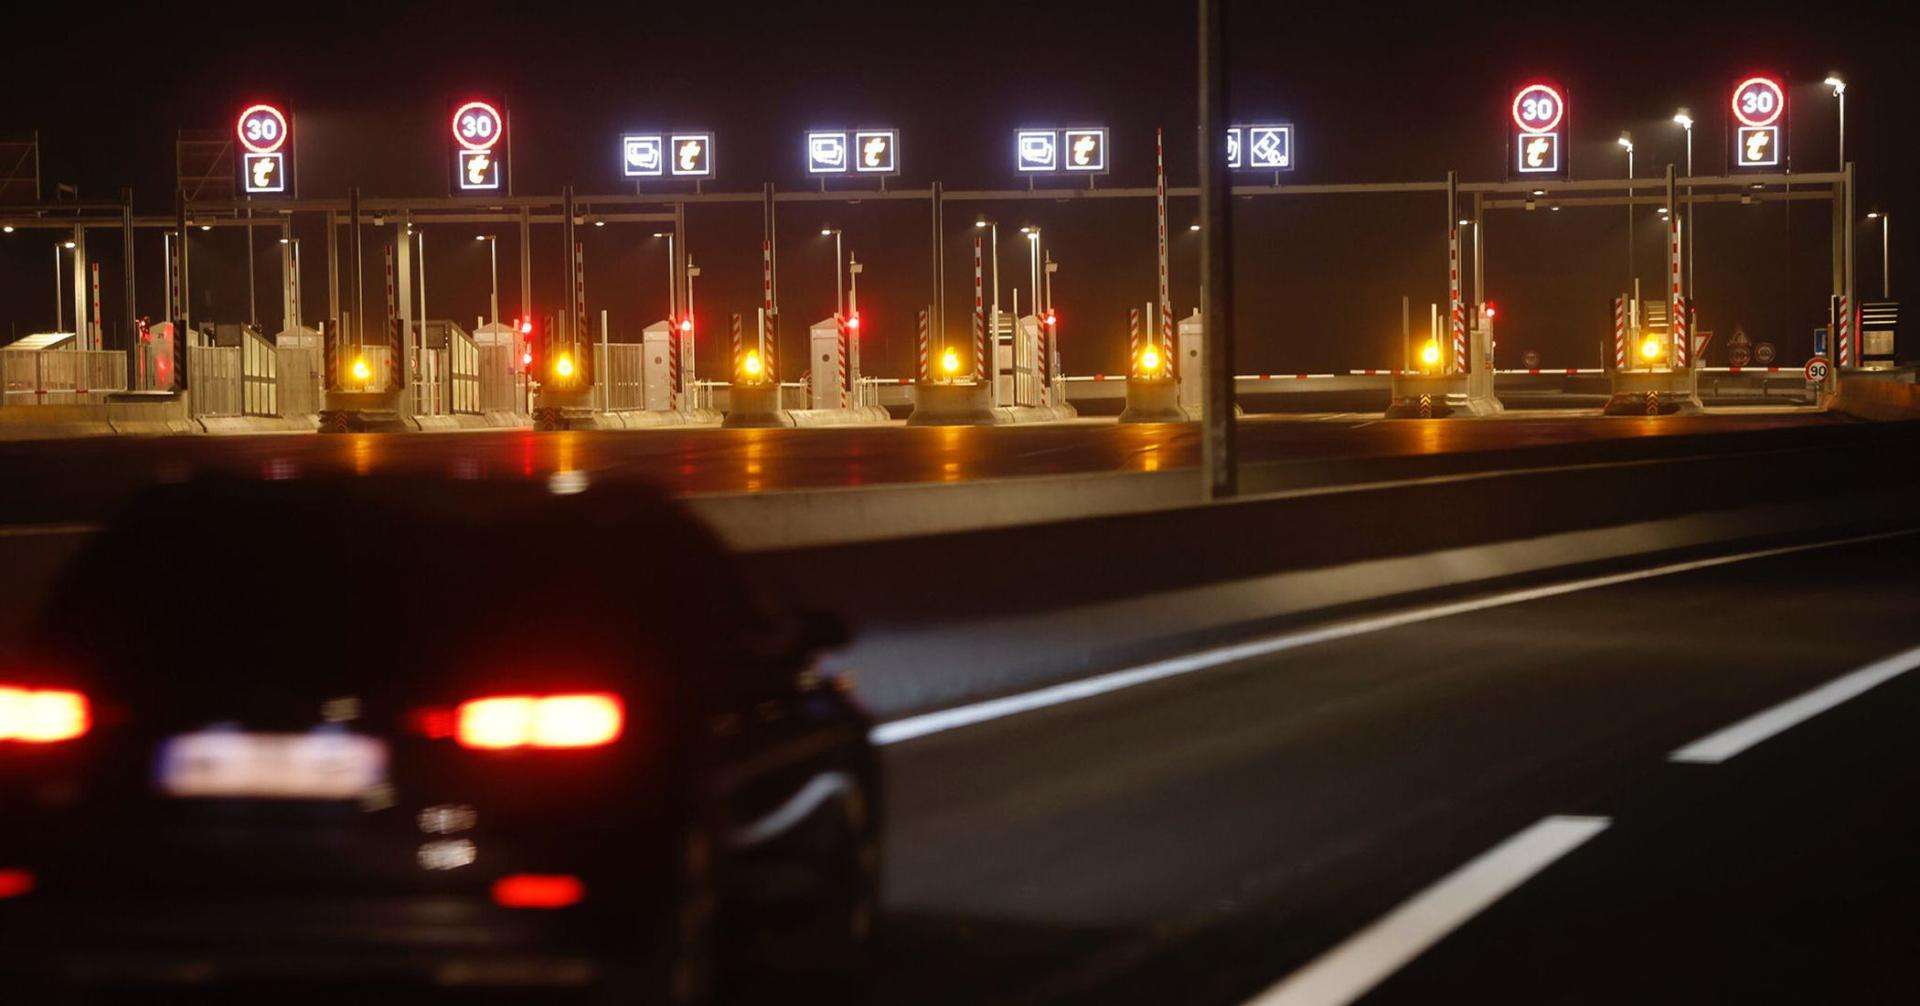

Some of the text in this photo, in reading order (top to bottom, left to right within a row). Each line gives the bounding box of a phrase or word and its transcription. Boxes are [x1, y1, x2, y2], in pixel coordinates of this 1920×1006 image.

[1522, 99, 1553, 120] 30
[1742, 92, 1773, 113] 30
[246, 119, 277, 141] 30
[462, 116, 491, 138] 30
[680, 141, 701, 170] t
[864, 137, 885, 166] t
[1073, 136, 1095, 165] t
[1526, 138, 1549, 167] t
[1746, 131, 1769, 161] t
[252, 158, 275, 187] t
[467, 155, 489, 184] t
[1811, 366, 1826, 376] 90
